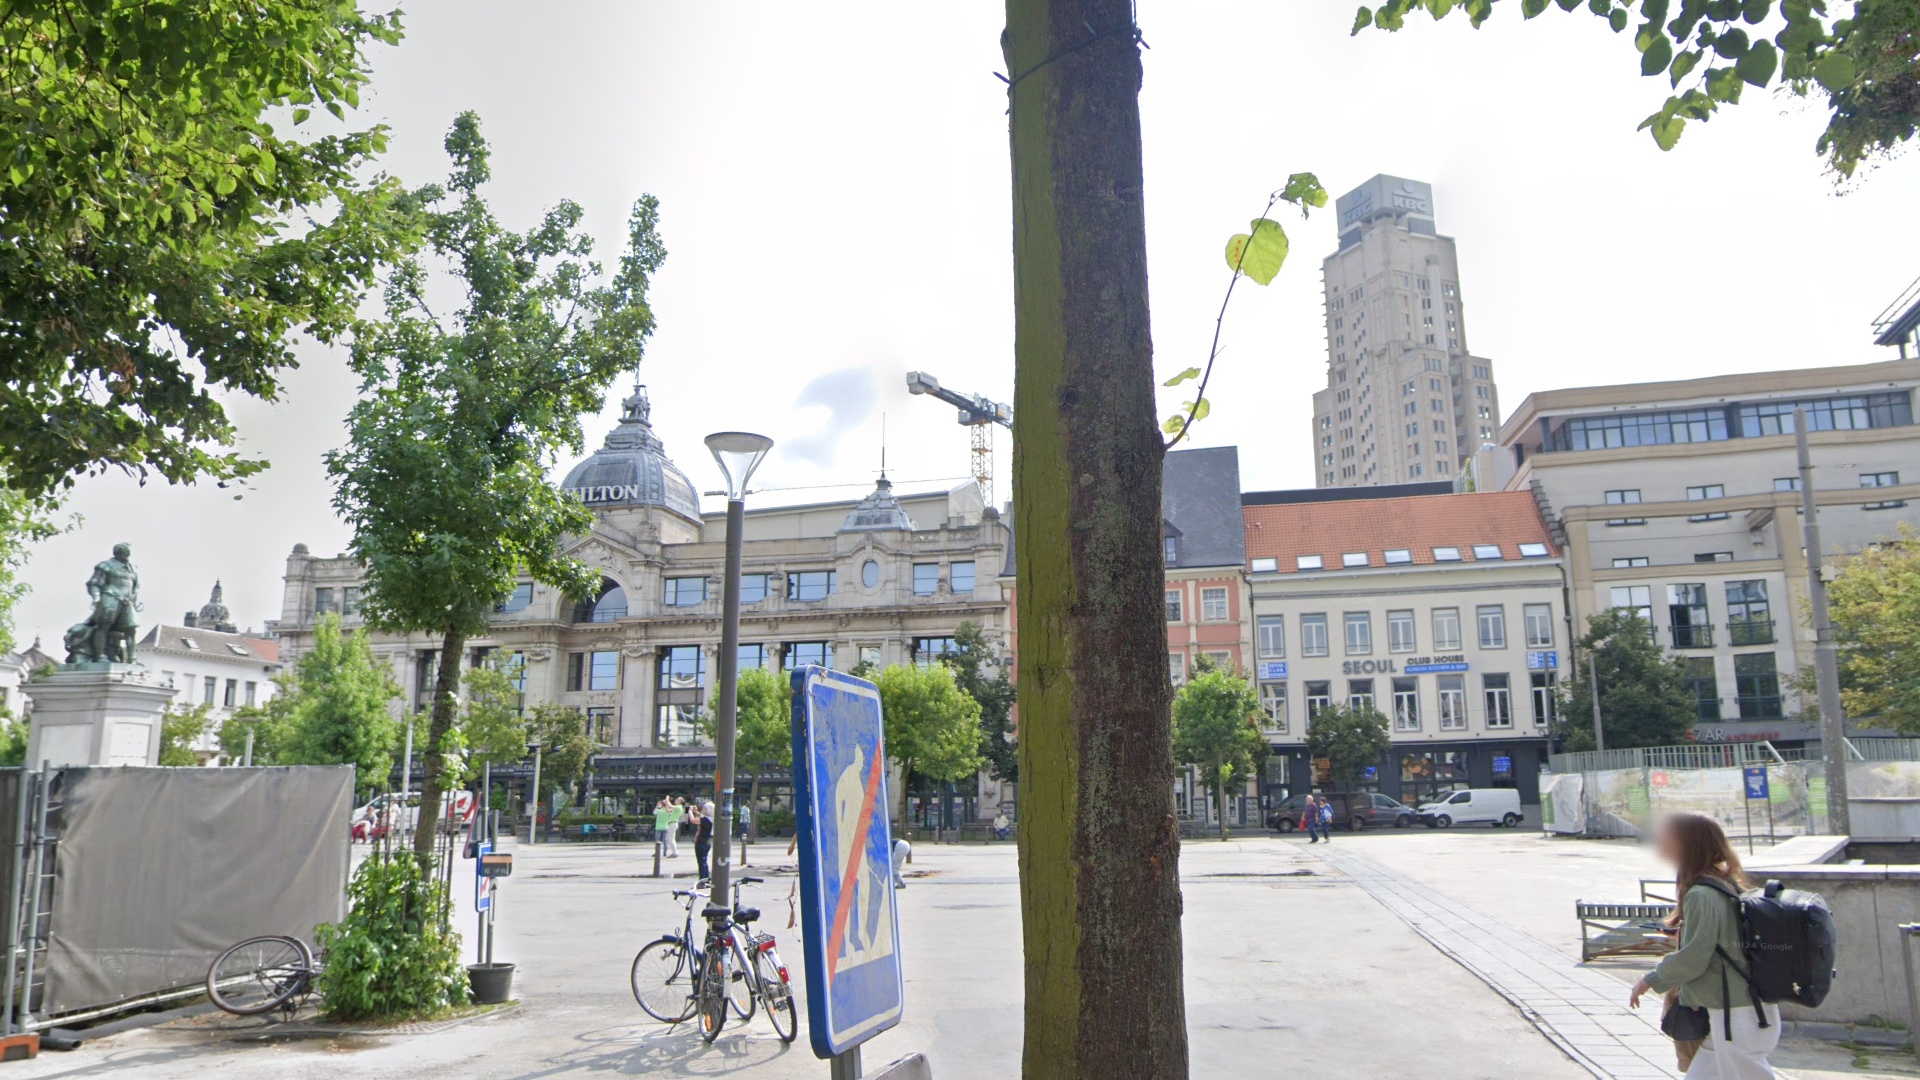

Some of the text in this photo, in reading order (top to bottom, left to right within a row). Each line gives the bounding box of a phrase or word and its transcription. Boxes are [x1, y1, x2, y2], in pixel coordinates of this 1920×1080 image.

[1393, 194, 1428, 213] KBC
[1343, 200, 1373, 227] KBC
[1342, 658, 1397, 675] SEOUL
[1406, 654, 1465, 665] CLUB HOUSE
